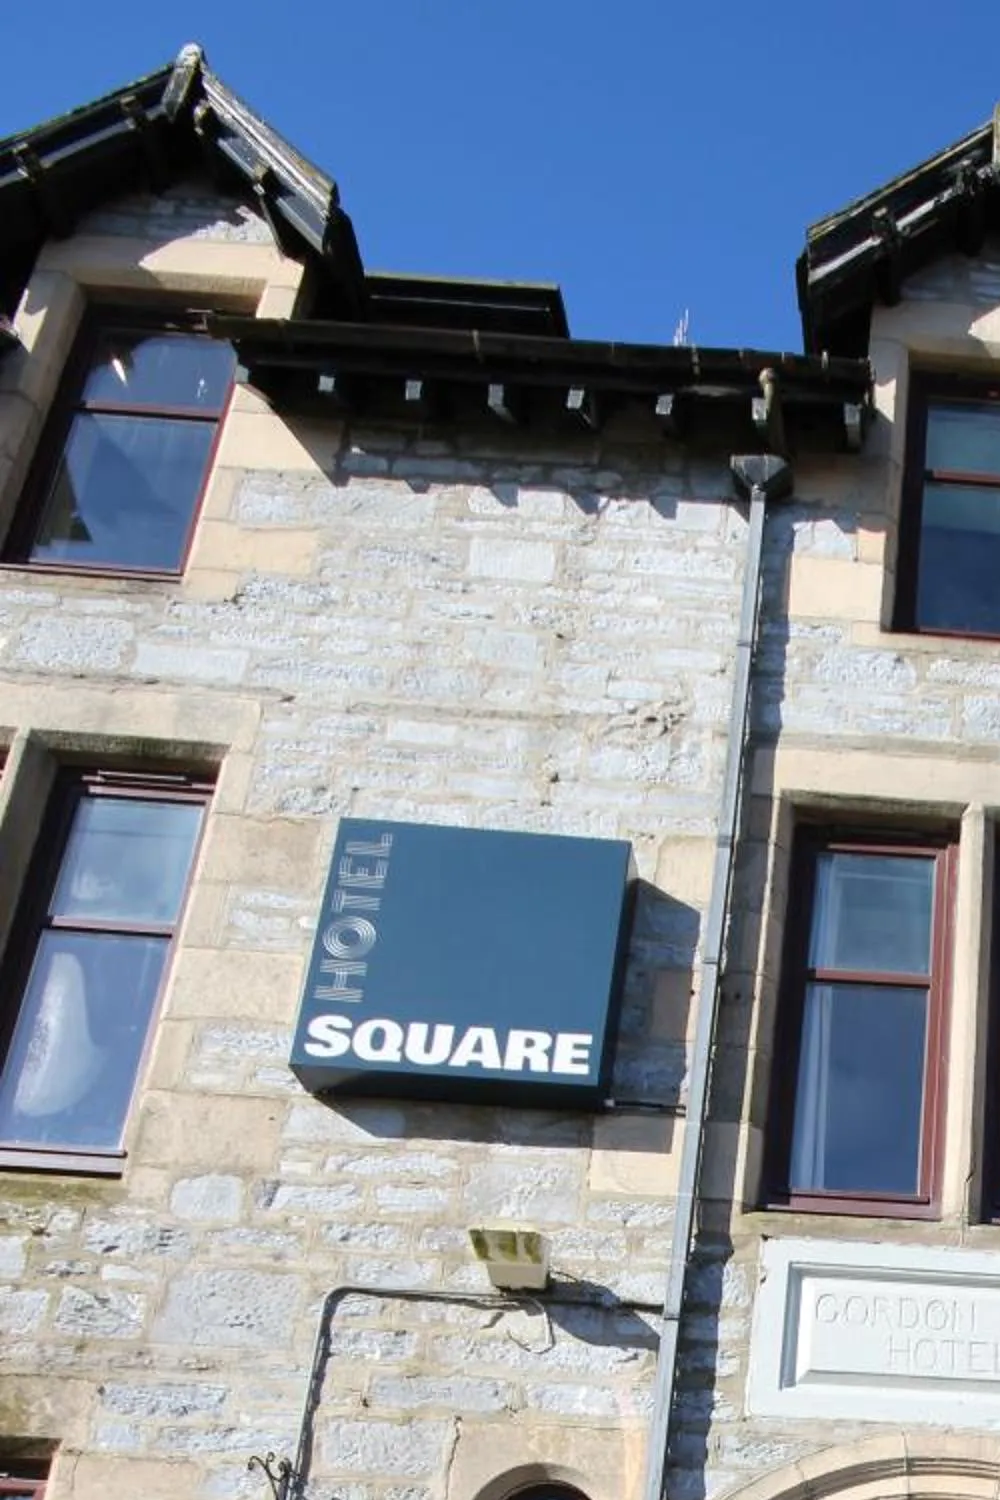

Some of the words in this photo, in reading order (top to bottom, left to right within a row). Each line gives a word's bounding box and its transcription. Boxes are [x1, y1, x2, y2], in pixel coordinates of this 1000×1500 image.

[314, 833, 394, 1002] HOTEL
[305, 1014, 593, 1075] SQUARE
[815, 1293, 976, 1331] GORDON
